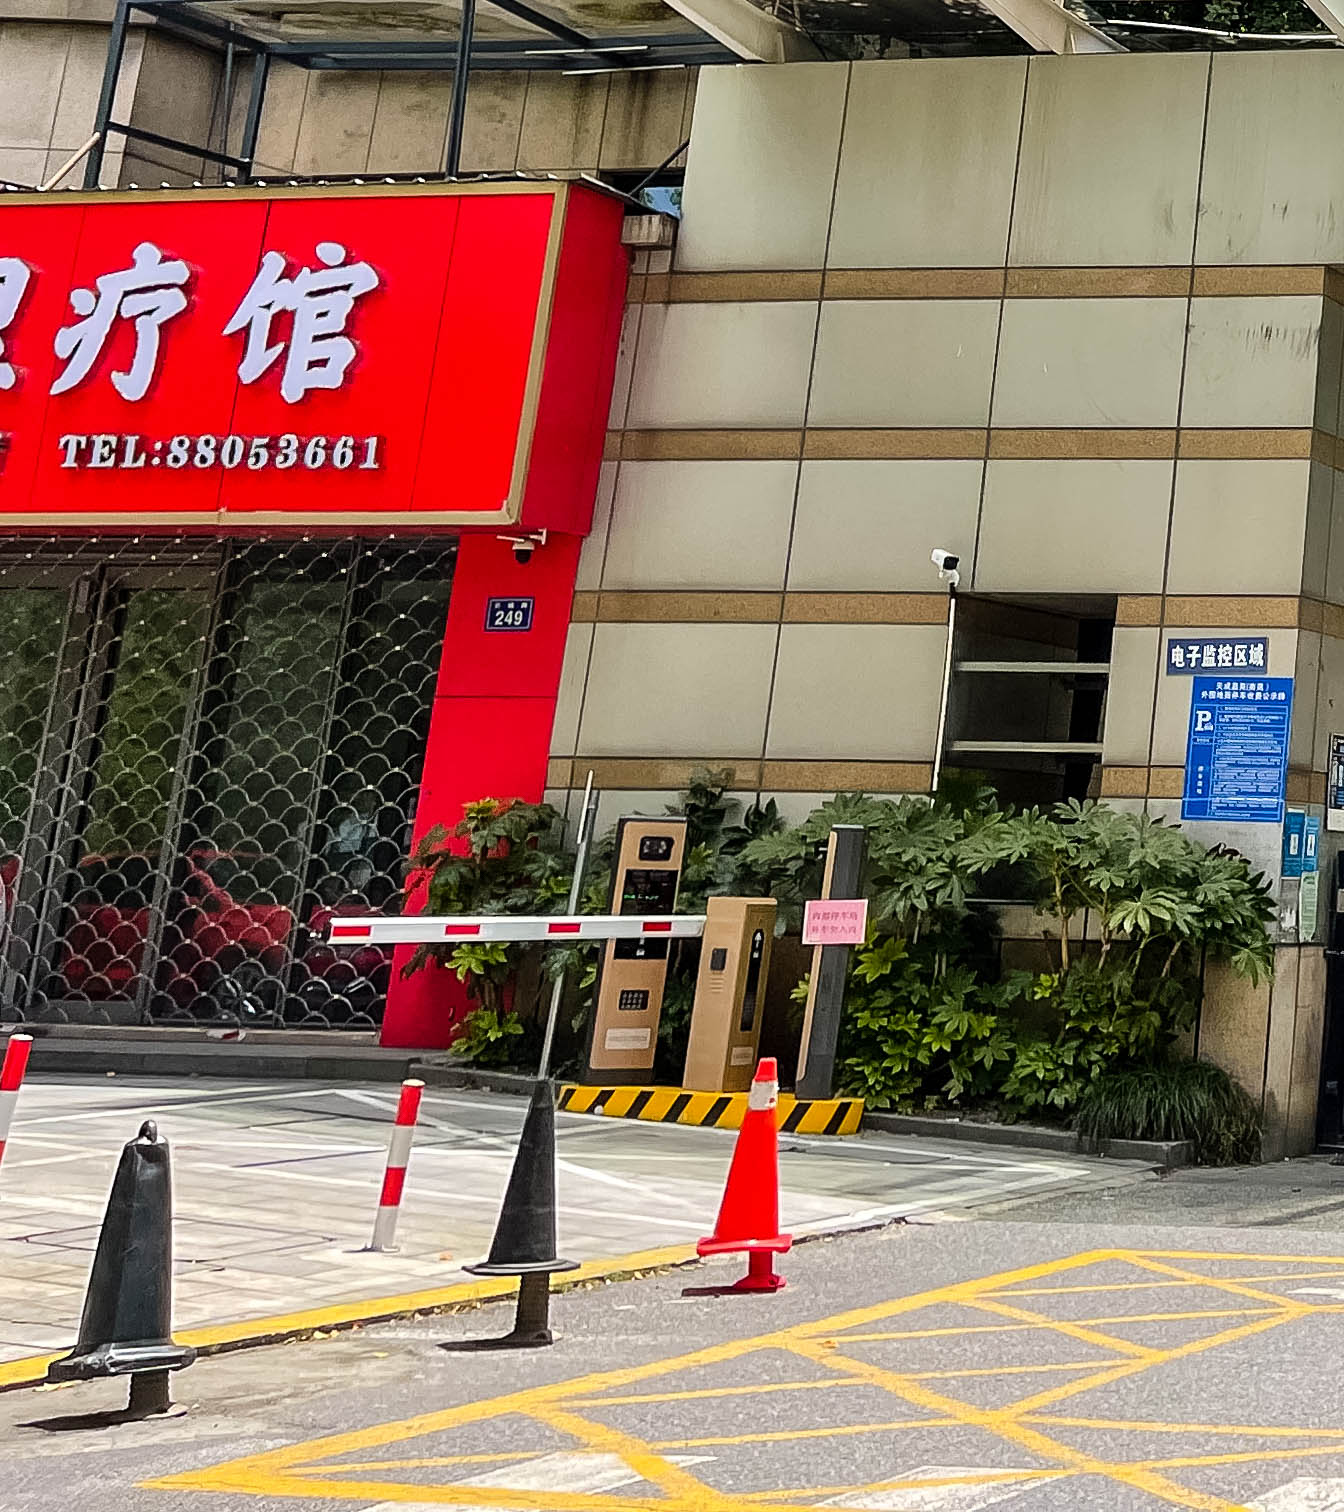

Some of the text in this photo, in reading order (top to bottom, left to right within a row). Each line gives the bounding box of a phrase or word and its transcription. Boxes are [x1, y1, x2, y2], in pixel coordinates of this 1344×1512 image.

[59, 433, 380, 470] TEL:88053661
[494, 610, 523, 626] 249
[1171, 643, 1264, 668] 电子监控区域
